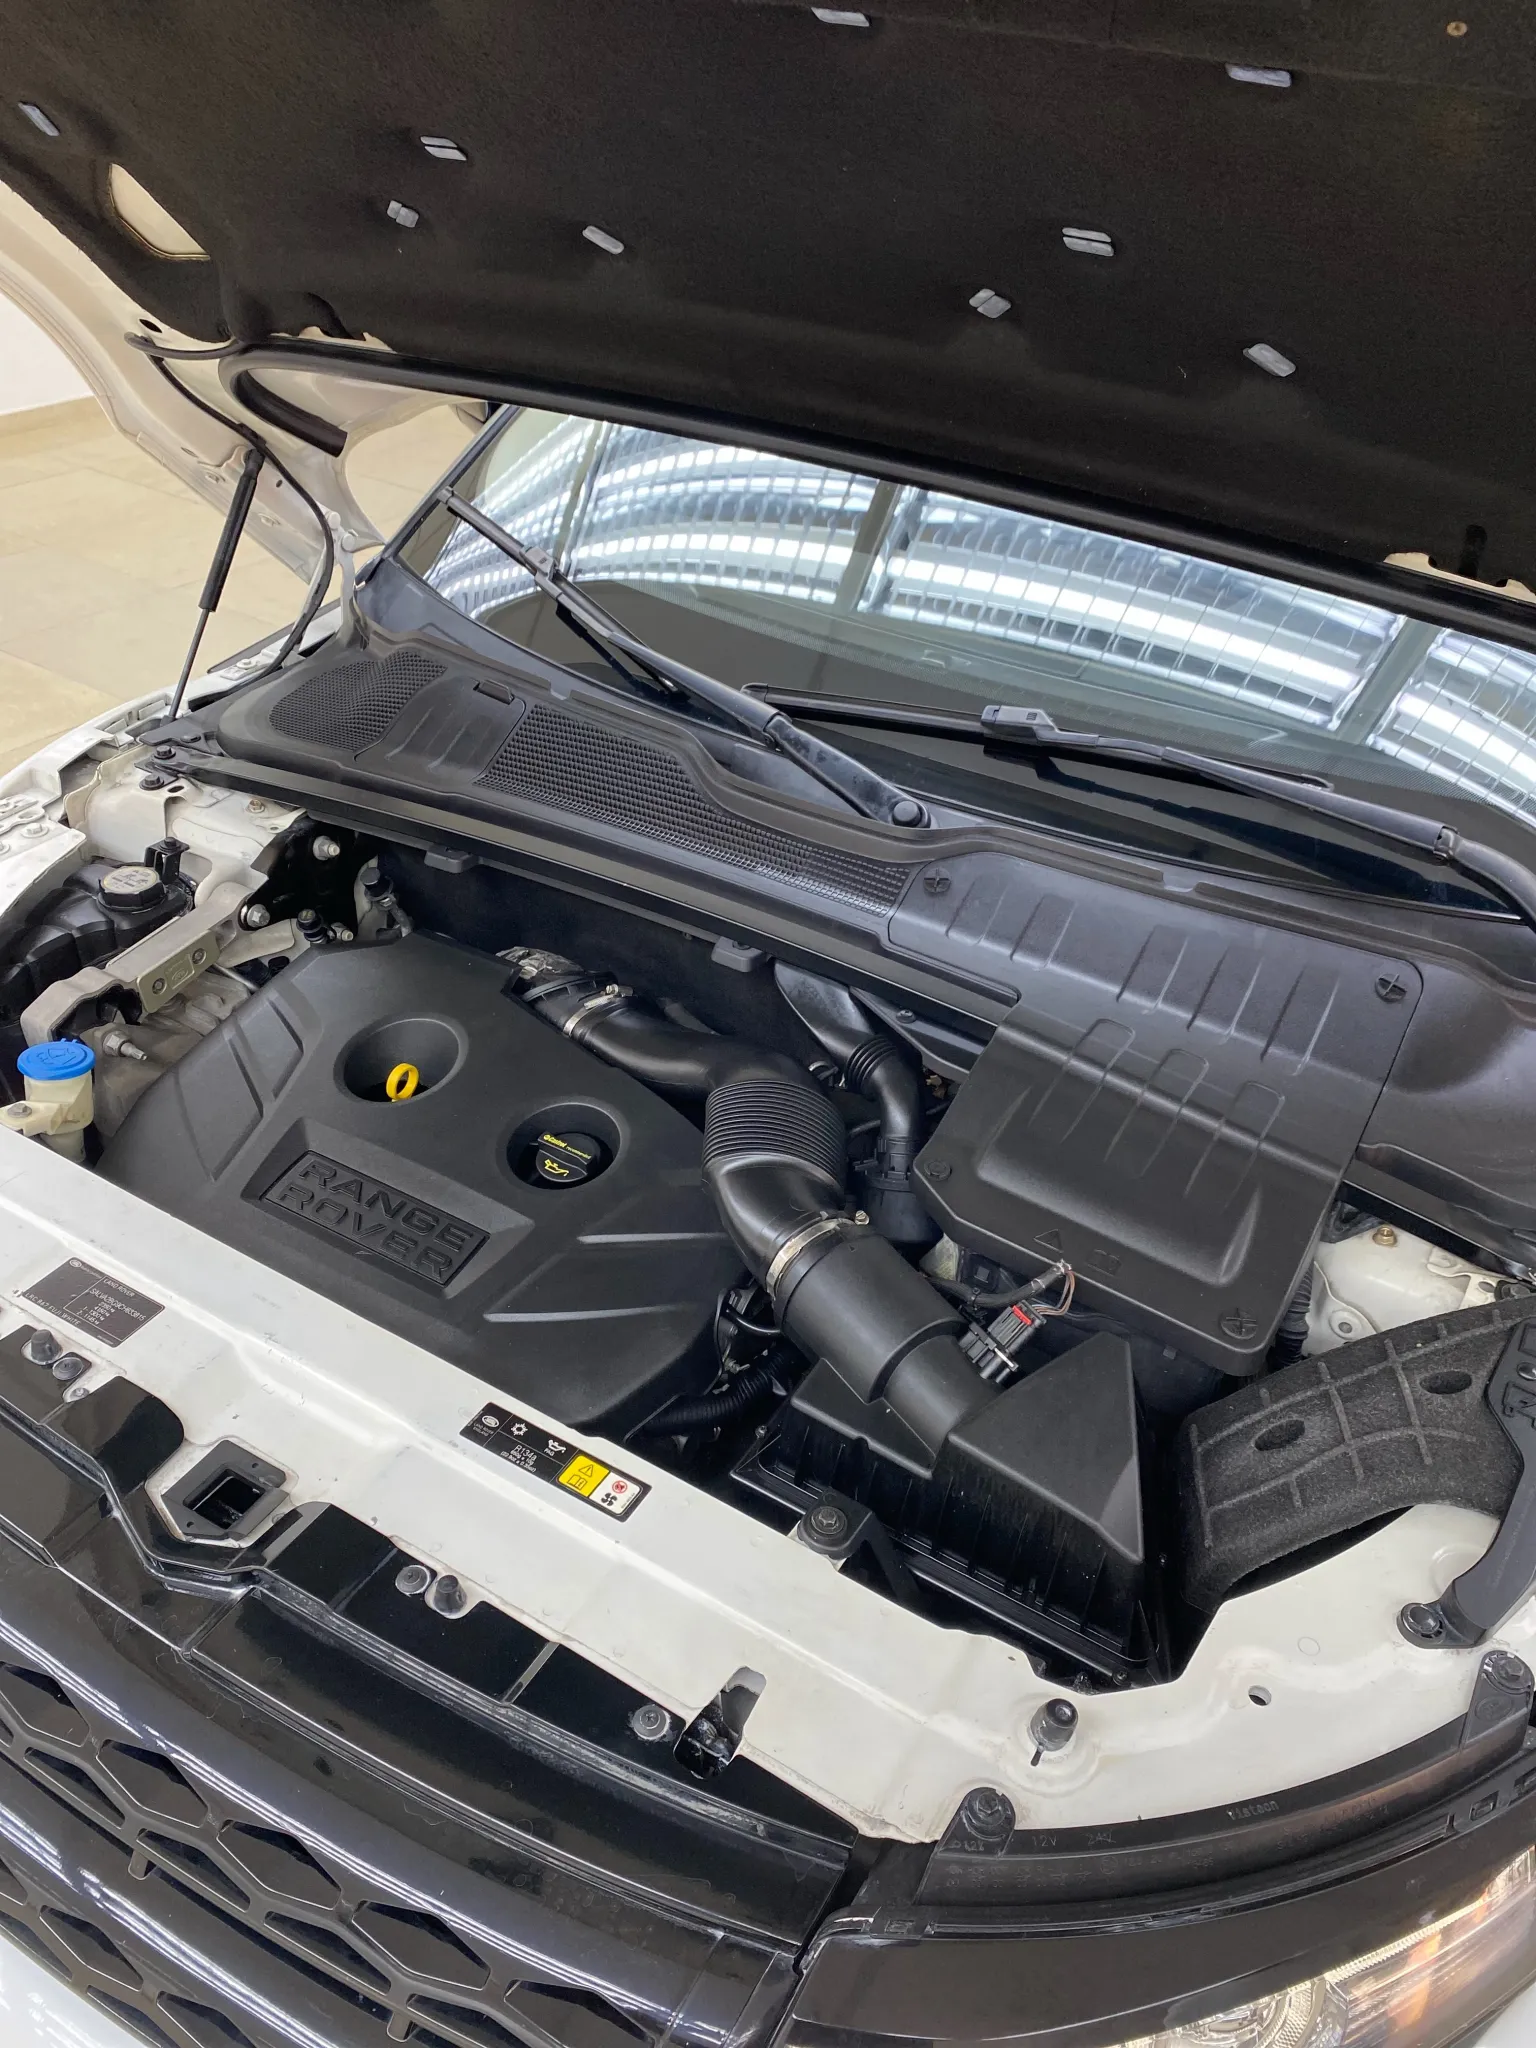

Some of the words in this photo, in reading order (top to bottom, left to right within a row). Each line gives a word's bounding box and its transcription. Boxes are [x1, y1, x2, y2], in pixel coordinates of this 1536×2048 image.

[298, 1158, 474, 1252] RANGE
[278, 1182, 453, 1280] ROVER
[103, 1279, 119, 1290] LAND
[117, 1284, 135, 1297] ROVER
[24, 1292, 38, 1303] LRC
[49, 1305, 62, 1316] FUJI
[61, 1311, 81, 1326] WHITE
[514, 1444, 537, 1461] R134a
